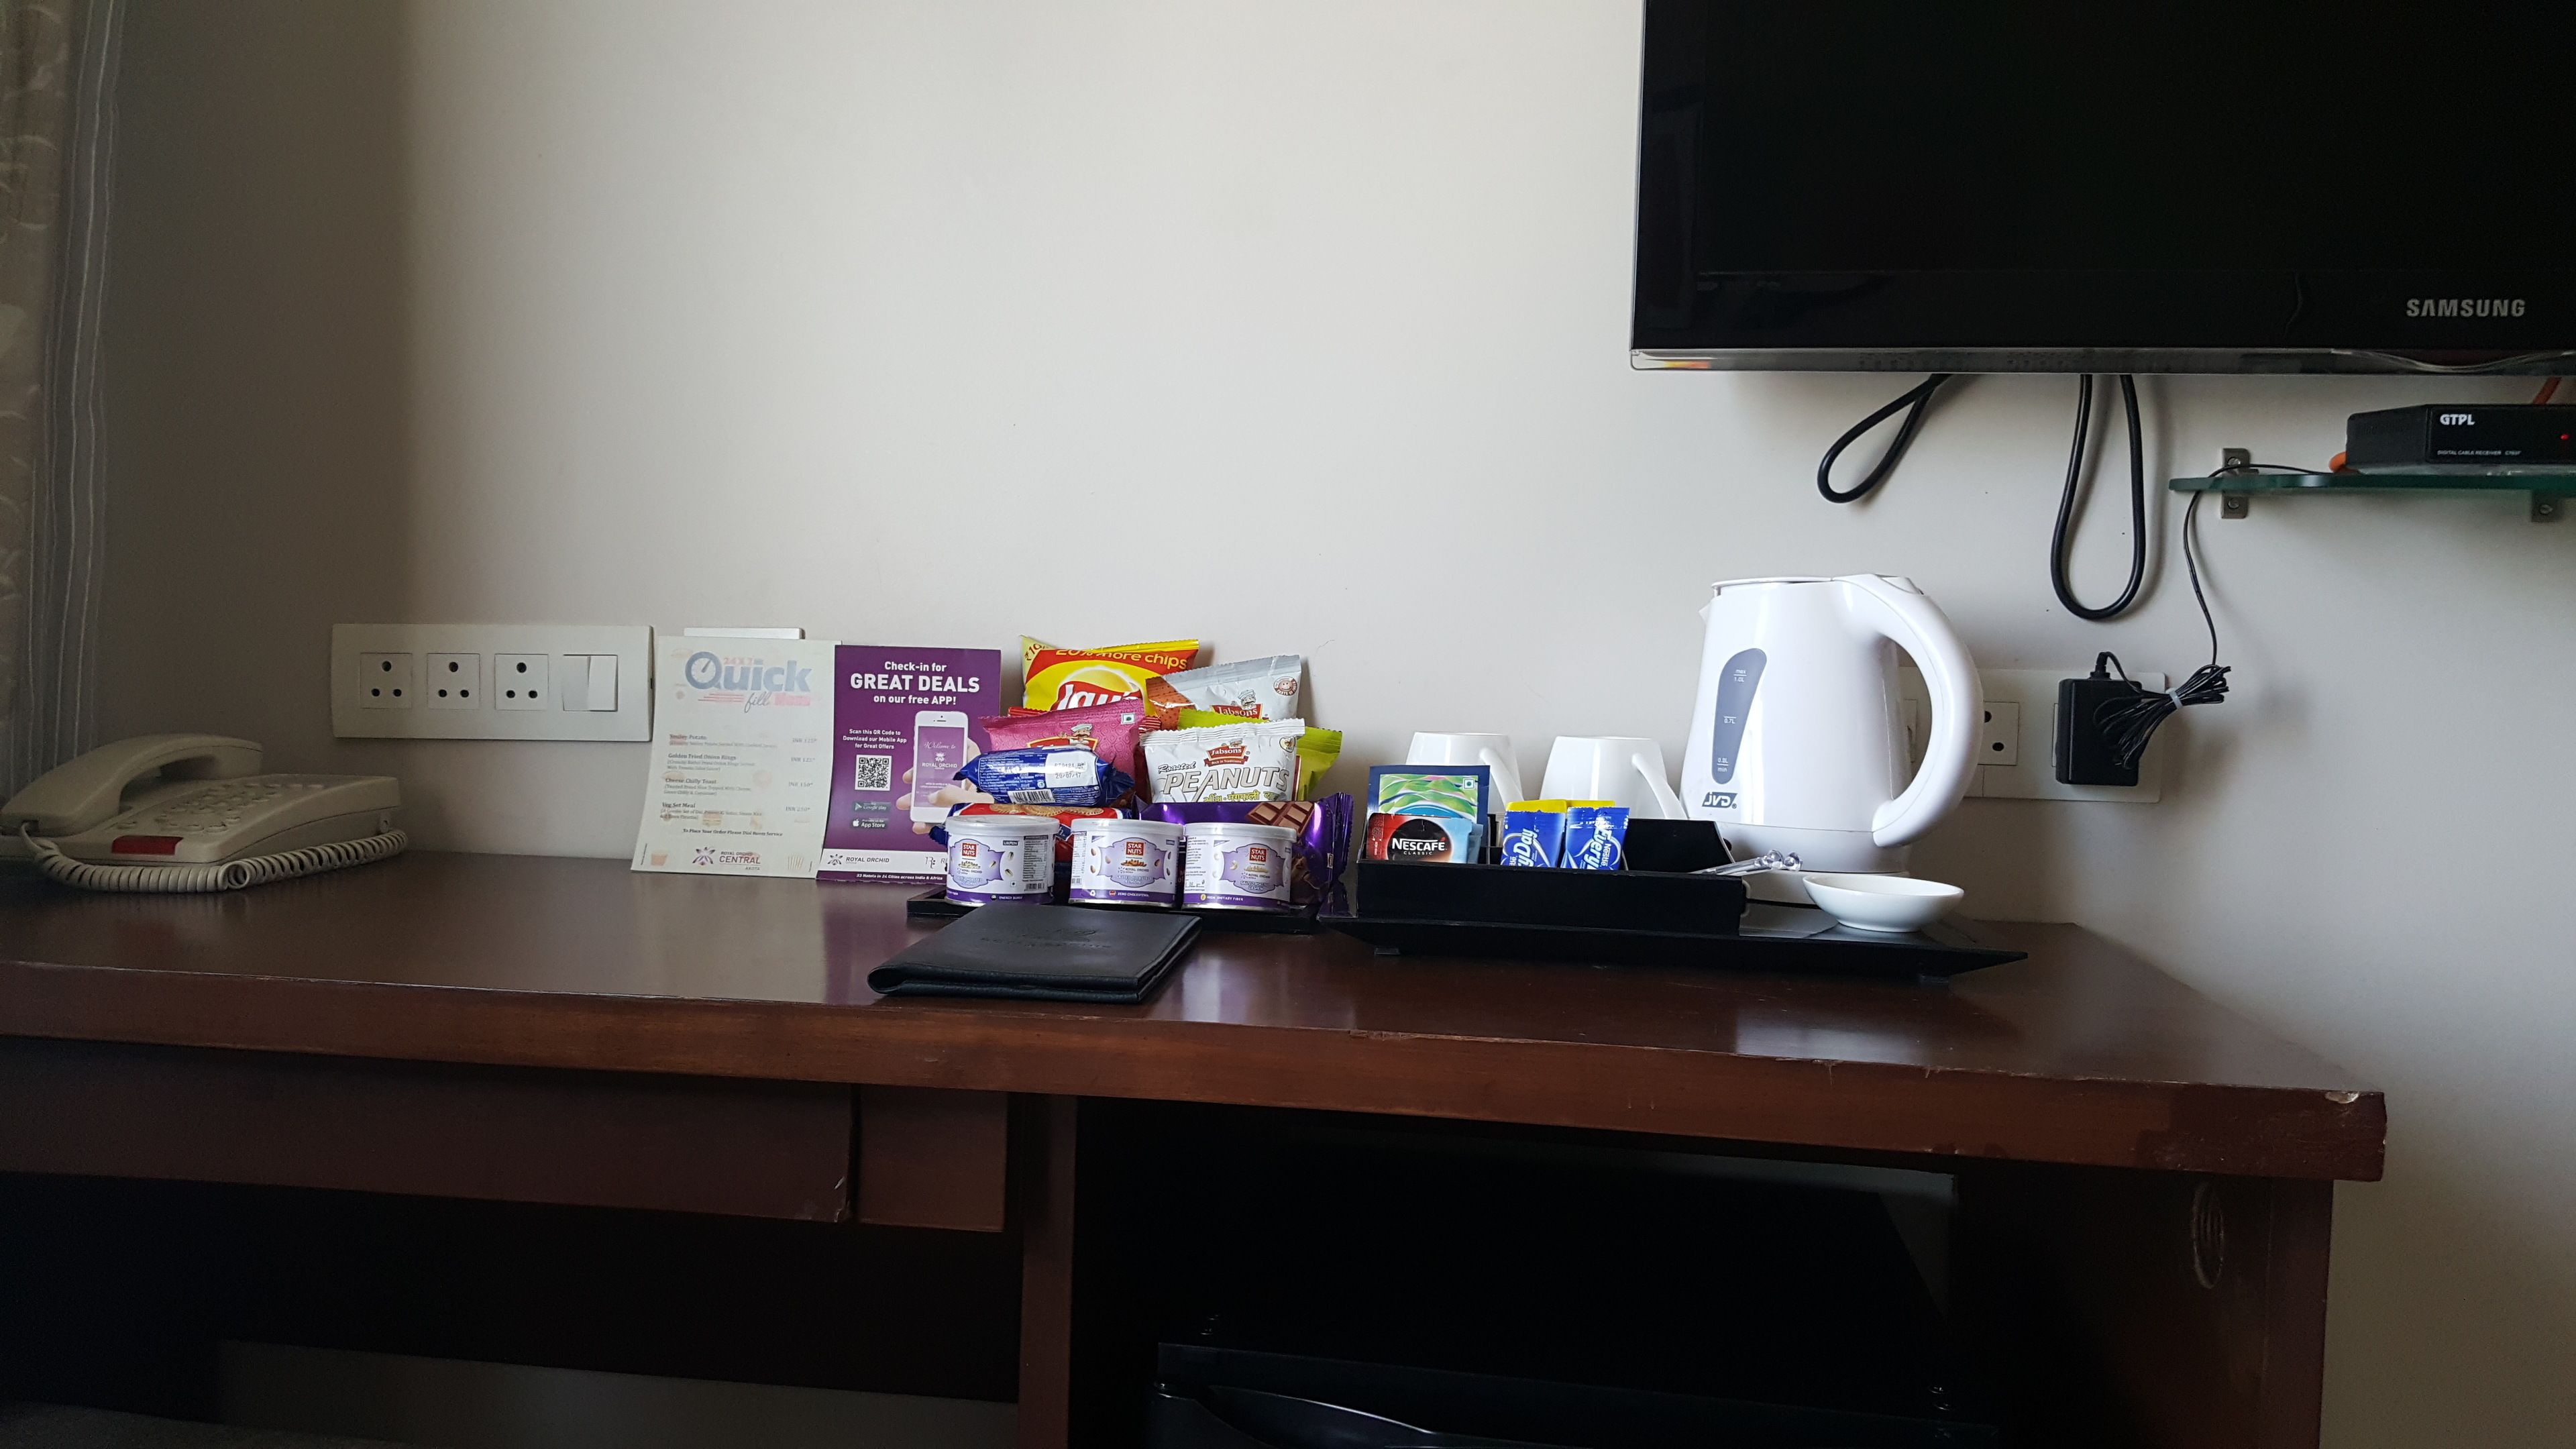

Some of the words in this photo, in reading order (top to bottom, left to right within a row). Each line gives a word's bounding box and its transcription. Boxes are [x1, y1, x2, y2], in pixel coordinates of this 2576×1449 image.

[2406, 299, 2526, 317] SAMSUNG
[2440, 414, 2475, 425] GTPL
[884, 661, 929, 672] Check-in
[932, 663, 947, 672] for
[1144, 653, 1187, 670] chips
[684, 651, 812, 692] Quick
[850, 673, 913, 690] GREAT
[918, 676, 980, 693] DEALS
[744, 692, 772, 714] fill
[908, 695, 929, 704] free
[931, 696, 957, 705] APP!
[1210, 747, 1242, 756] Jabsons
[1158, 761, 1197, 774] Roasted
[1163, 767, 1289, 798] PEANUTS
[719, 855, 761, 865] CENTRAL
